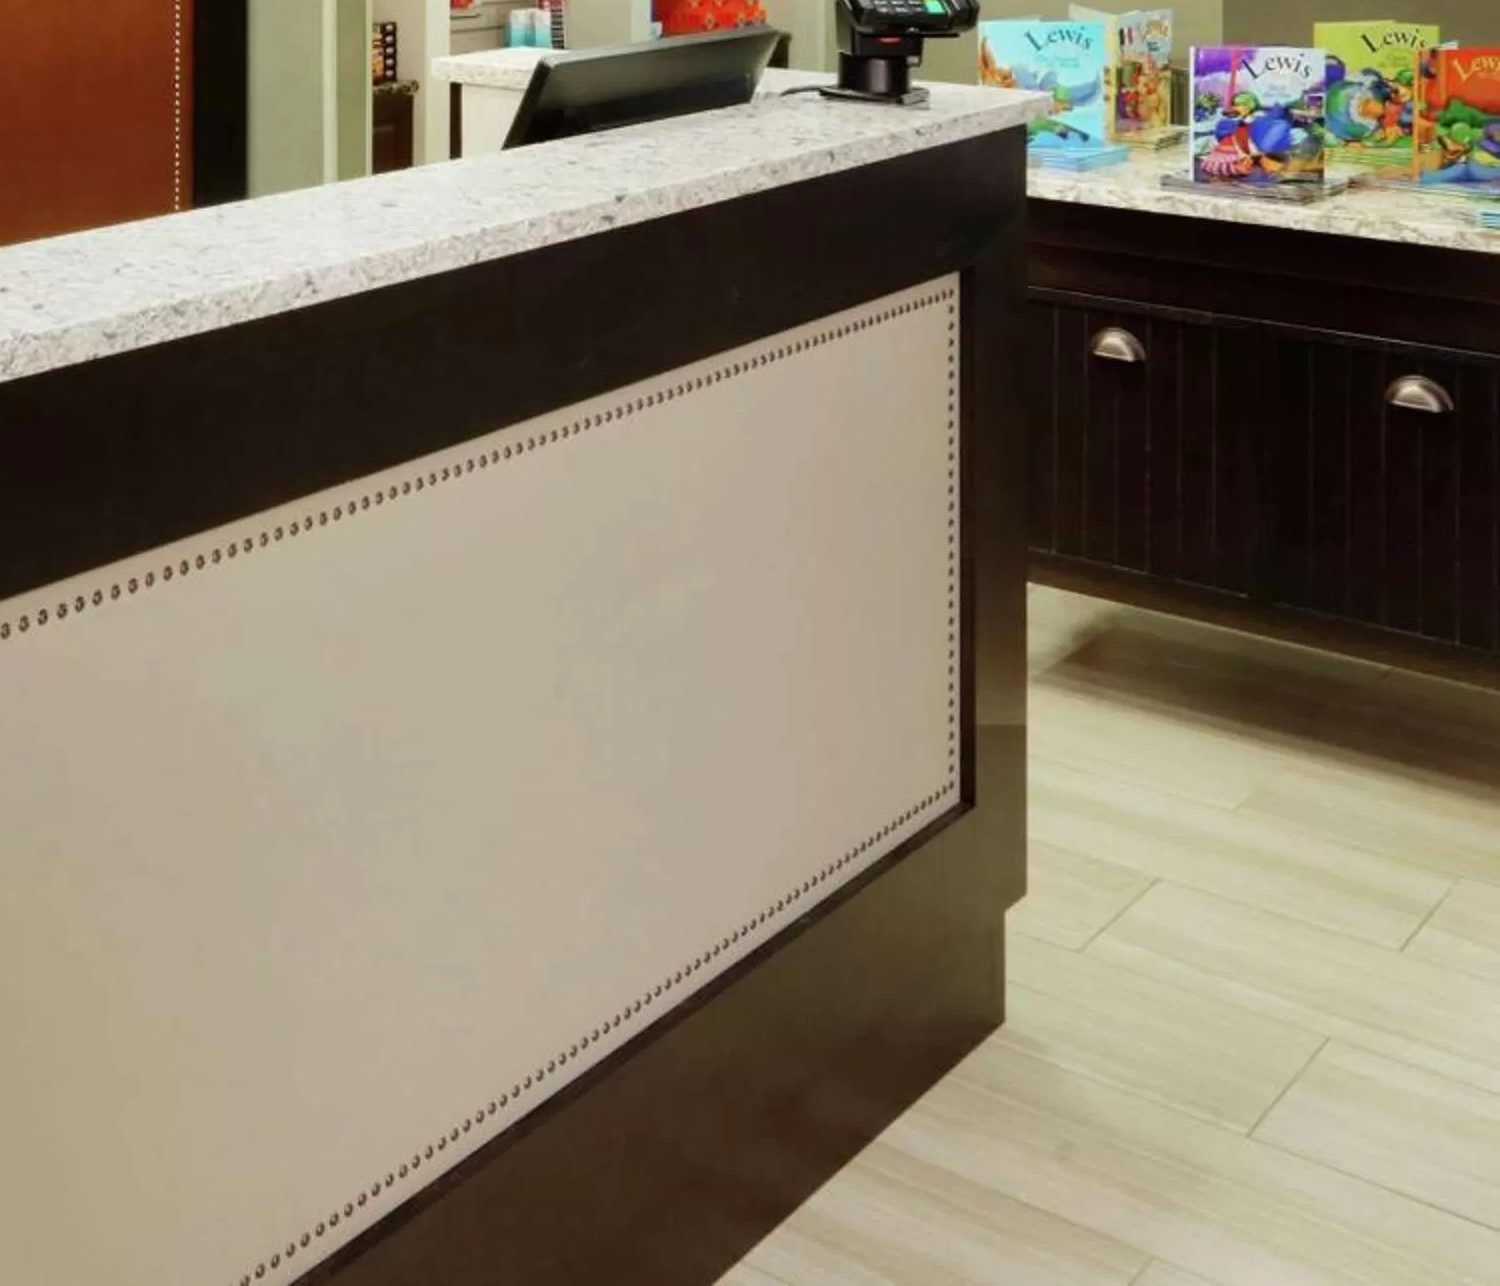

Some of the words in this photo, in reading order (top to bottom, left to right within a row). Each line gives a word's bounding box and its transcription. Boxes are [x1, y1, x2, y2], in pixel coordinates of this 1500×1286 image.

[1024, 25, 1095, 51] Lewis
[1360, 27, 1430, 53] Lewis
[1241, 52, 1314, 80] Lewis
[1453, 55, 1500, 83] Lew
